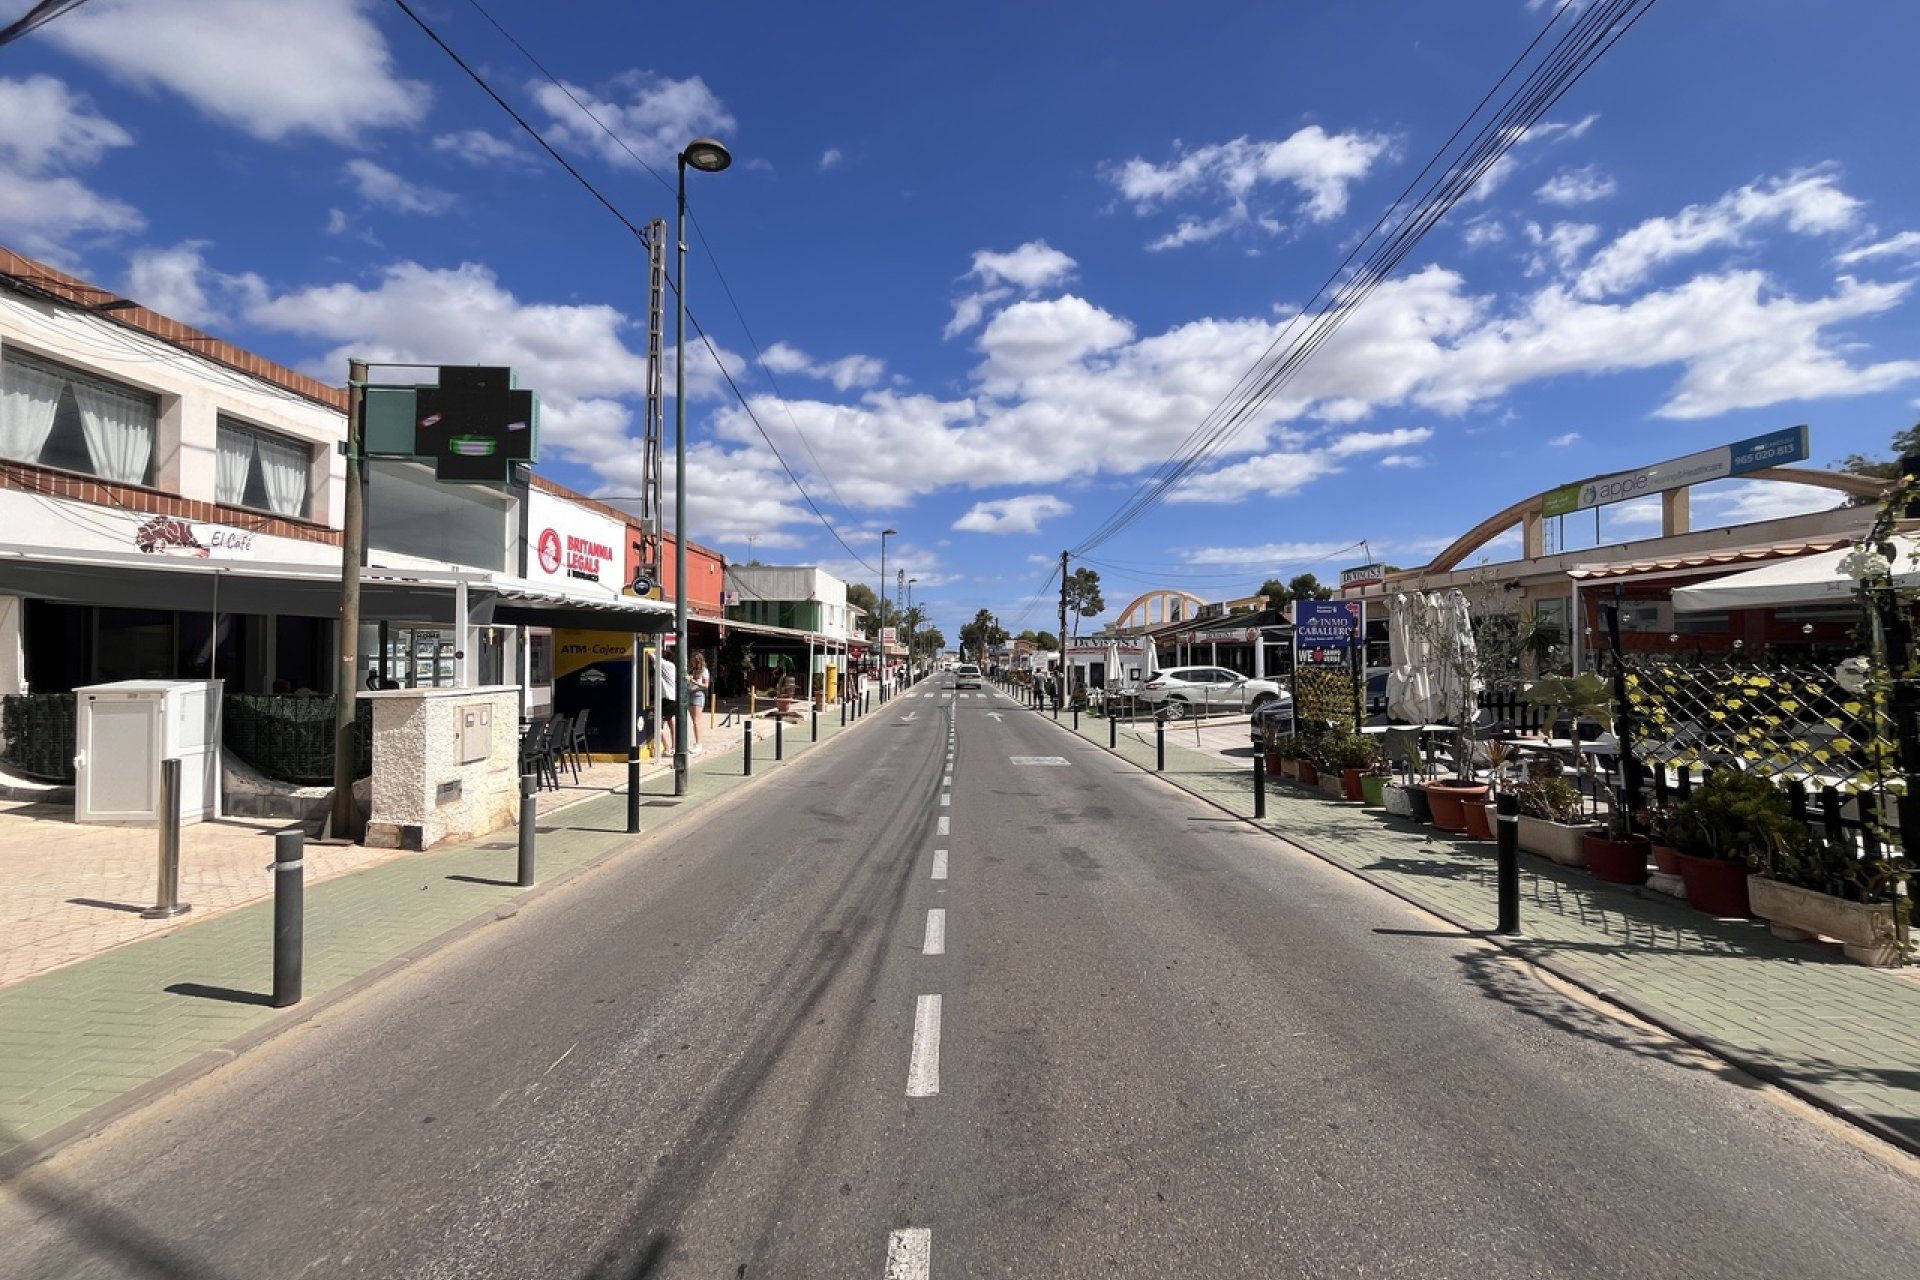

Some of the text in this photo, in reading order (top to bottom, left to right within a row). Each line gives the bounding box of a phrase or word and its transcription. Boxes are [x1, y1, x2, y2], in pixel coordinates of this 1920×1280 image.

[1734, 453, 1753, 466] 965
[1755, 449, 1774, 462] 020
[1776, 443, 1795, 456] 813
[1600, 474, 1648, 499] apple
[212, 531, 225, 547] El
[567, 534, 613, 562] BRITANNIA
[567, 551, 600, 574] LEGALS
[1321, 618, 1348, 627] INMO
[561, 644, 627, 656] ATM Cajero
[1299, 649, 1314, 662] WE
